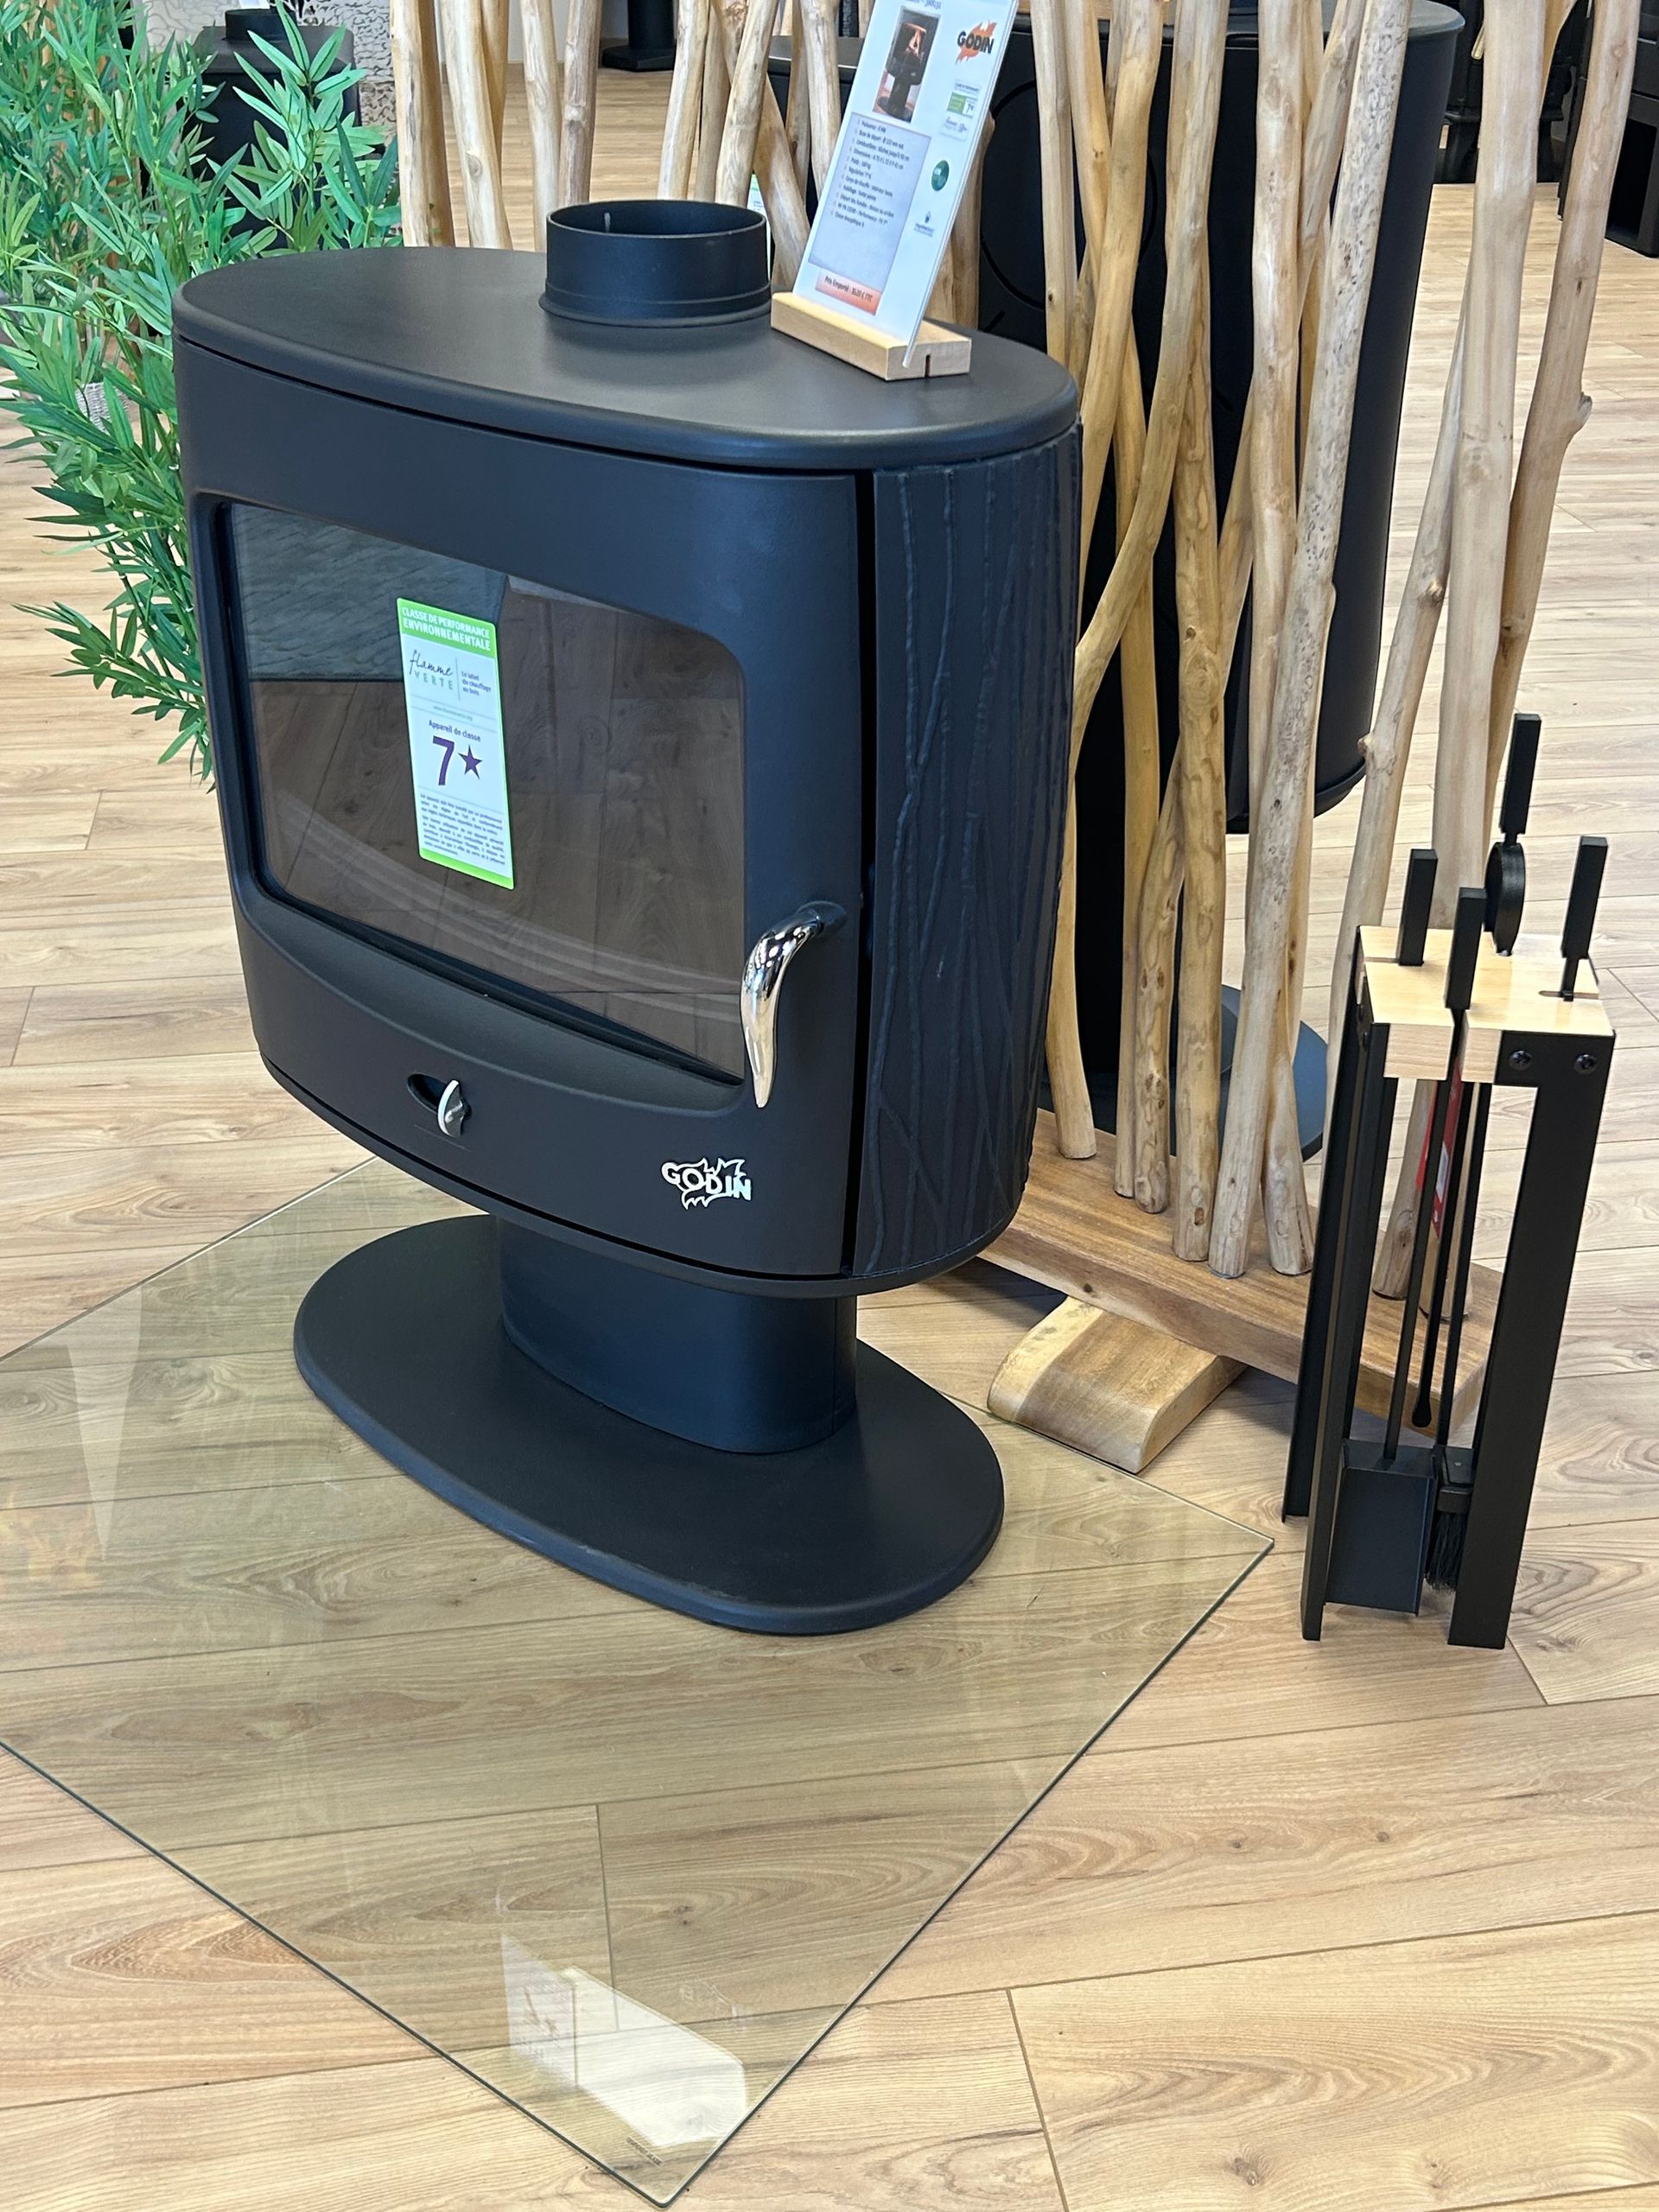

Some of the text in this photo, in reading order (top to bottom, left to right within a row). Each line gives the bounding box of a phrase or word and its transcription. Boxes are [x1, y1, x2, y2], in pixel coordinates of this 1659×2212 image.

[957, 30, 995, 54] GODIN
[402, 607, 491, 639] CLASSE DE PERFORMANCE
[403, 617, 491, 652] ENVIRONNEMENTALE
[414, 669, 454, 691] VERTE
[429, 719, 481, 742] Appareil de classe
[432, 734, 455, 786] 7
[661, 1159, 752, 1205] GODIN
